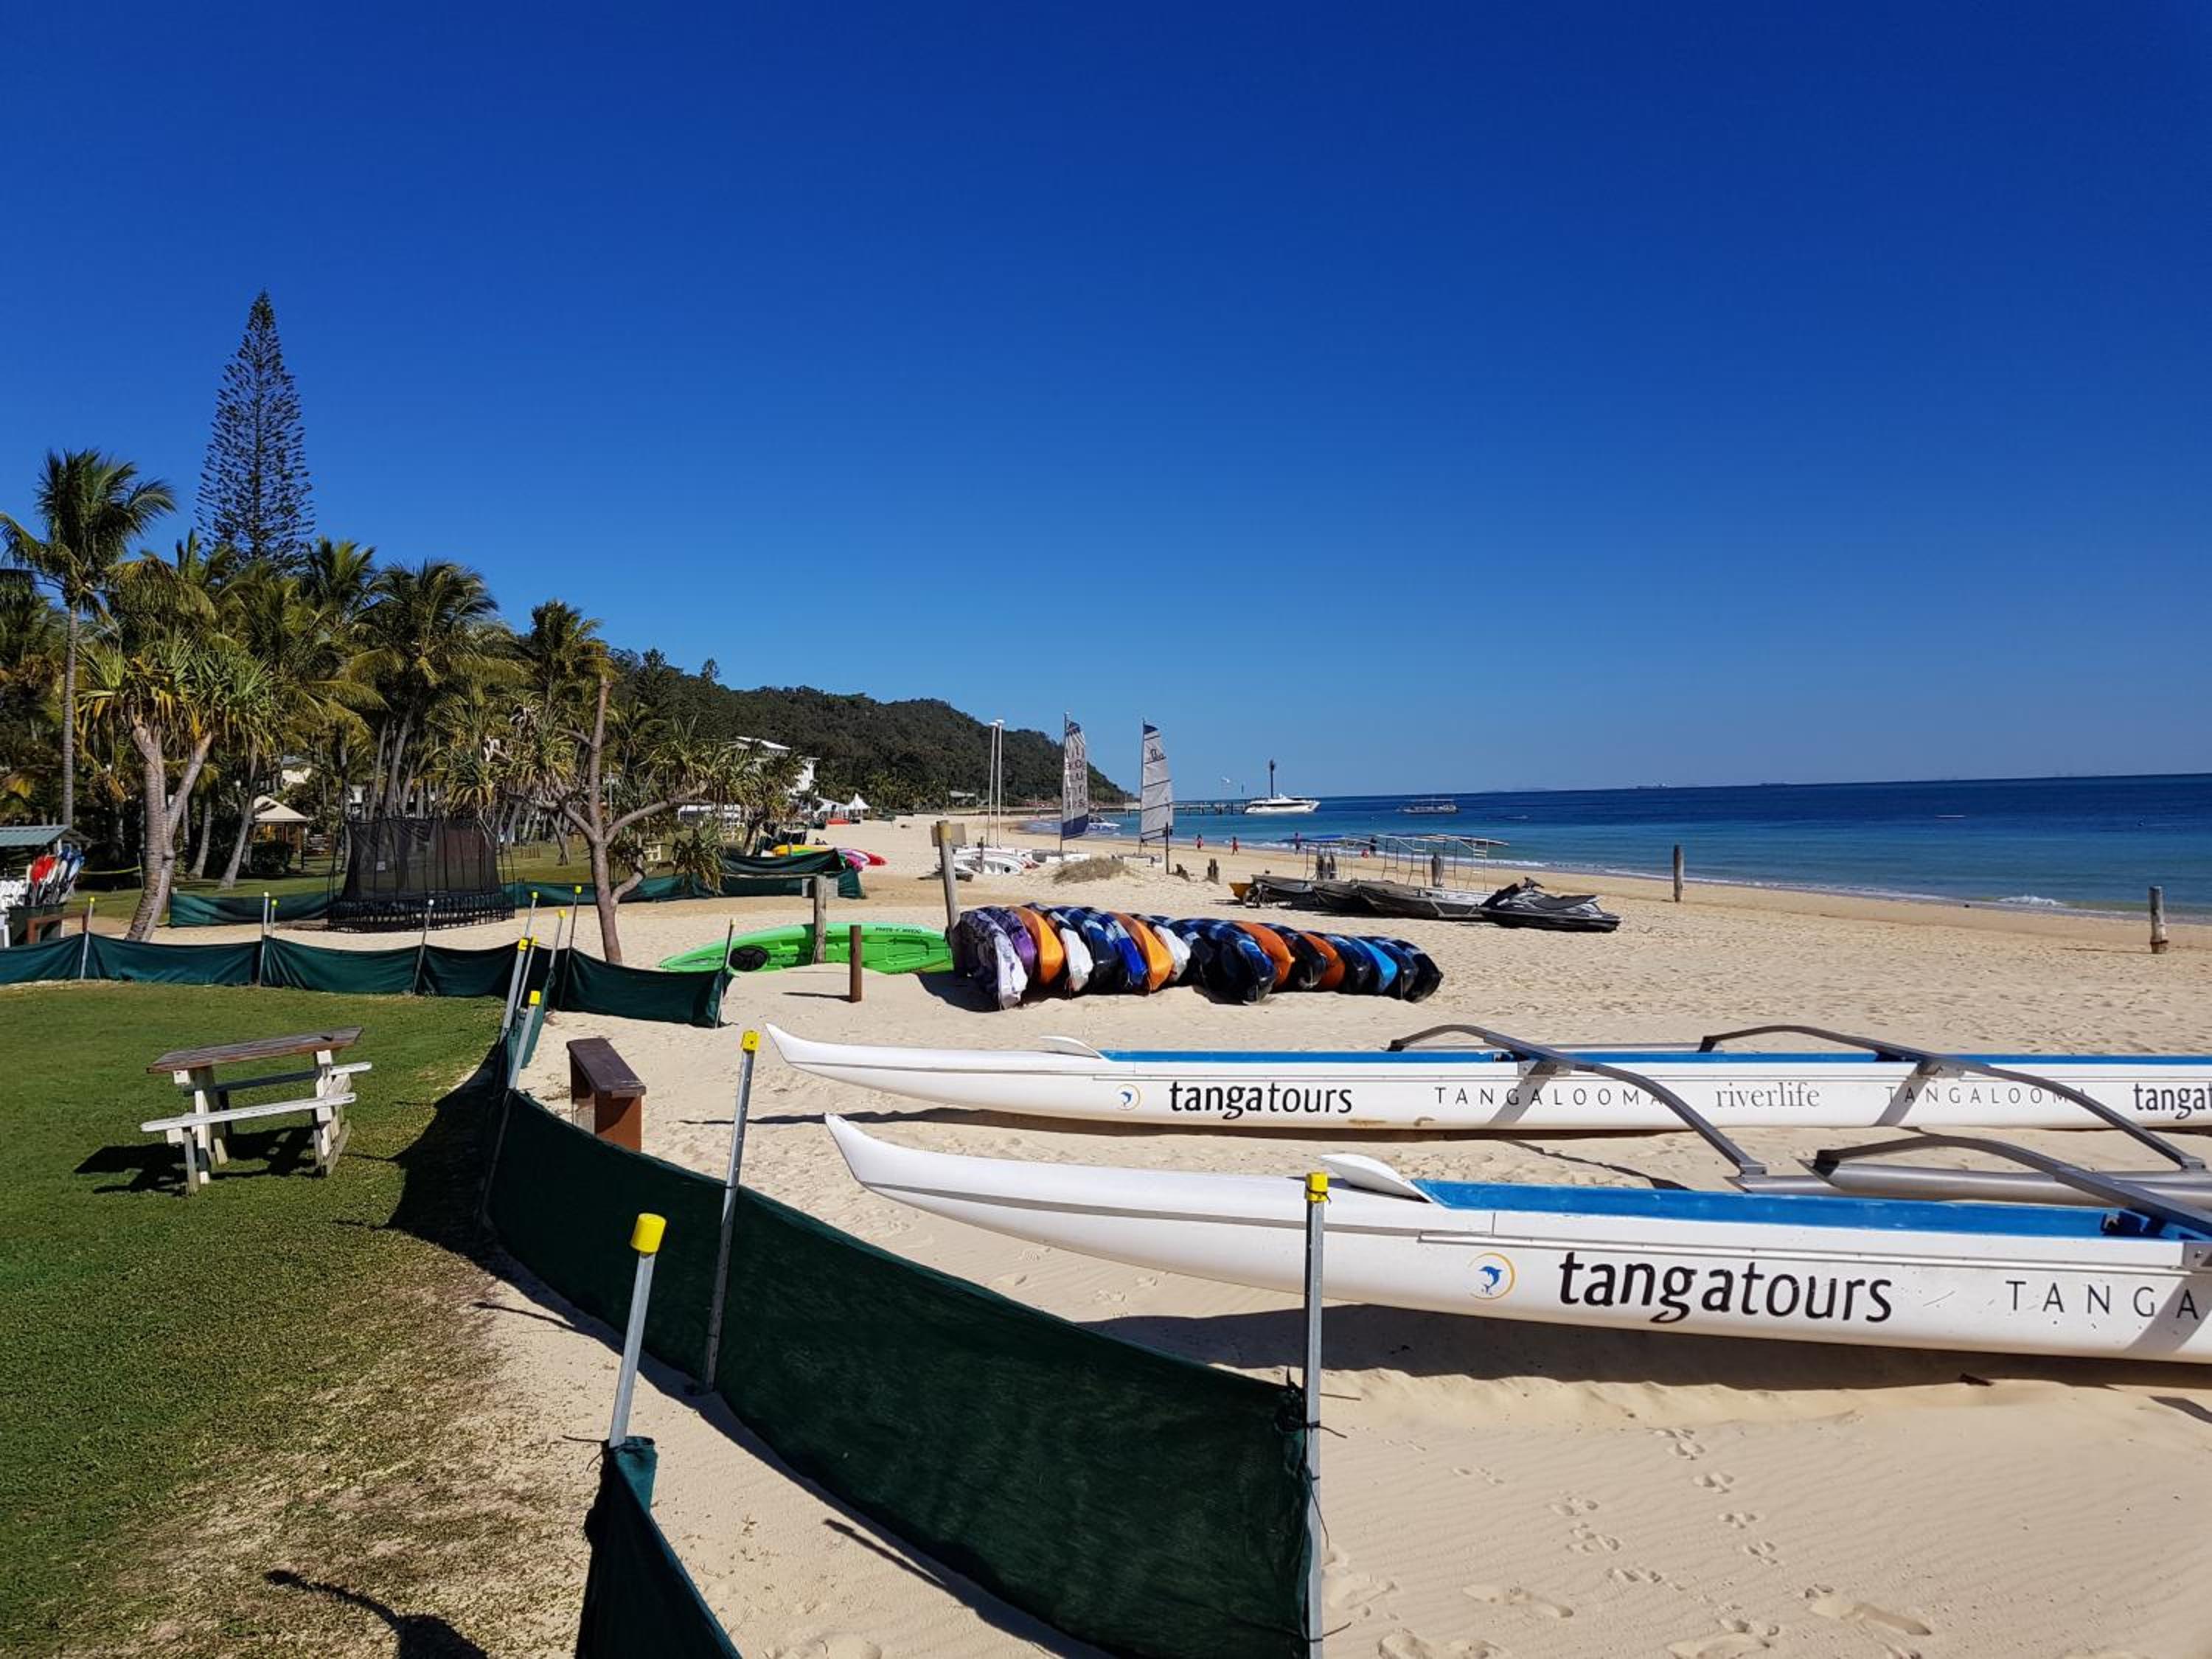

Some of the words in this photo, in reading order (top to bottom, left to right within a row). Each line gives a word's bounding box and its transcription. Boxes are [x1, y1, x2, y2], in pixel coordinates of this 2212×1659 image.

[1169, 1081, 1352, 1120] tangatours
[1716, 1082, 1820, 1107] riverlife
[1559, 1251, 1893, 1324] tangatours
[2006, 1280, 2199, 1320] TANGA
